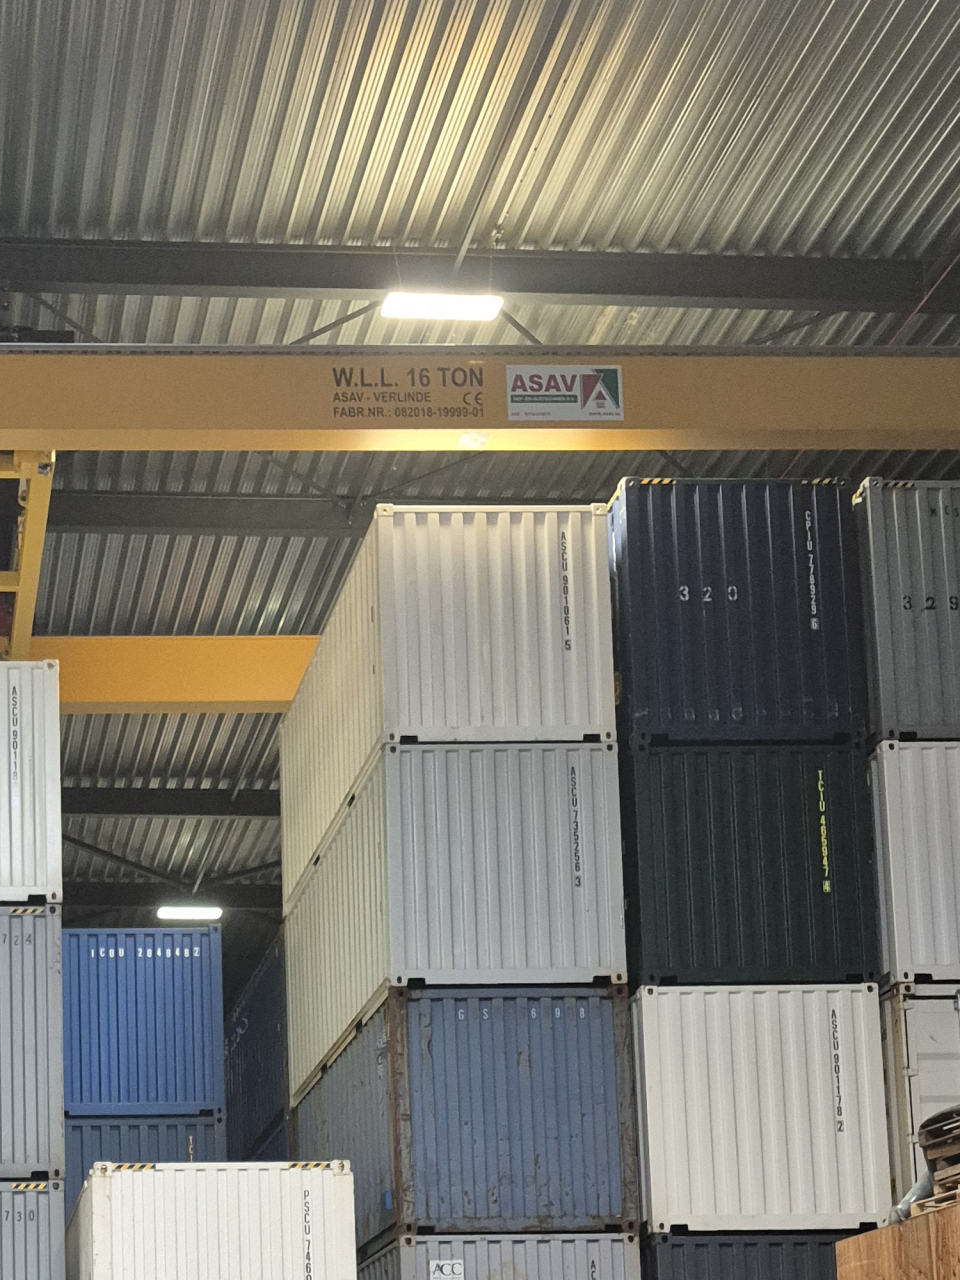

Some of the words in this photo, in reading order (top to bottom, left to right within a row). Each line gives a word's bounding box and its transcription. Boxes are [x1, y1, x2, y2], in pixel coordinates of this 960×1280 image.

[332, 367, 399, 387] W.L.L.
[406, 367, 431, 387] 16
[437, 367, 484, 387] TON
[510, 374, 577, 393] ASAV
[333, 391, 364, 403] ASAV
[373, 391, 432, 403] VERLINDE
[394, 406, 485, 418] 082018-19999-01
[561, 531, 569, 572] ASCU
[562, 575, 570, 636] 901061
[811, 618, 819, 630] 6
[565, 639, 572, 651] 5
[570, 766, 578, 808] ASCU
[572, 810, 581, 873] 735256
[575, 876, 582, 887] 3
[831, 1009, 839, 1051] ASCU
[833, 1053, 842, 1117] 901178
[837, 1120, 844, 1133] 2
[303, 1190, 311, 1236] PSCU
[431, 1262, 463, 1277] ACC
